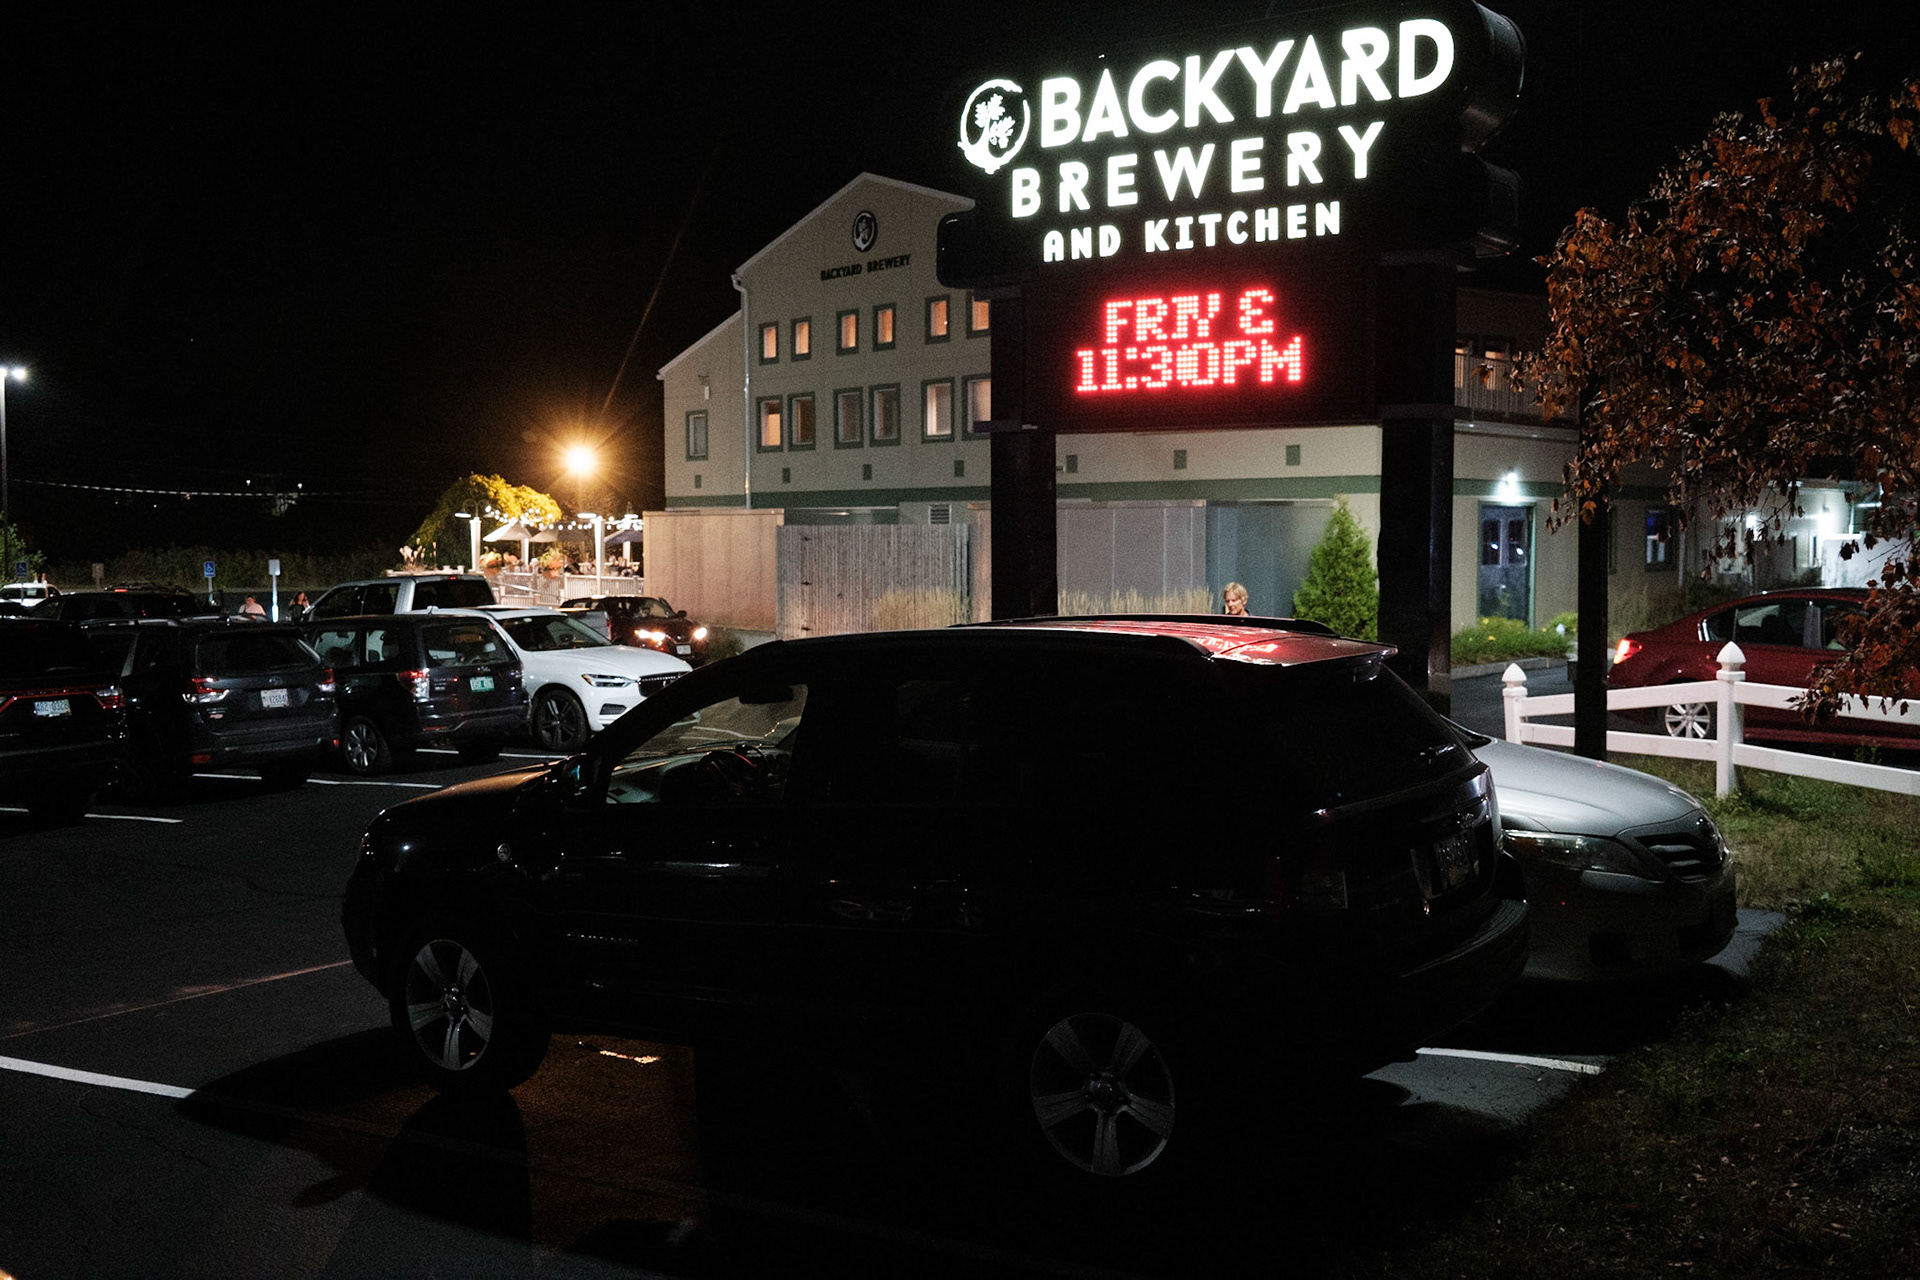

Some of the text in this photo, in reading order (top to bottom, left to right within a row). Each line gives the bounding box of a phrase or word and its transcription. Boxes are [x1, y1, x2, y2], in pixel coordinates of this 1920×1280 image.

[1040, 18, 1455, 149] BACKYARD
[1011, 120, 1385, 219] BREWERY
[820, 254, 911, 281] BACKYARD BREWERY
[1043, 200, 1340, 263] AND KITCHEN
